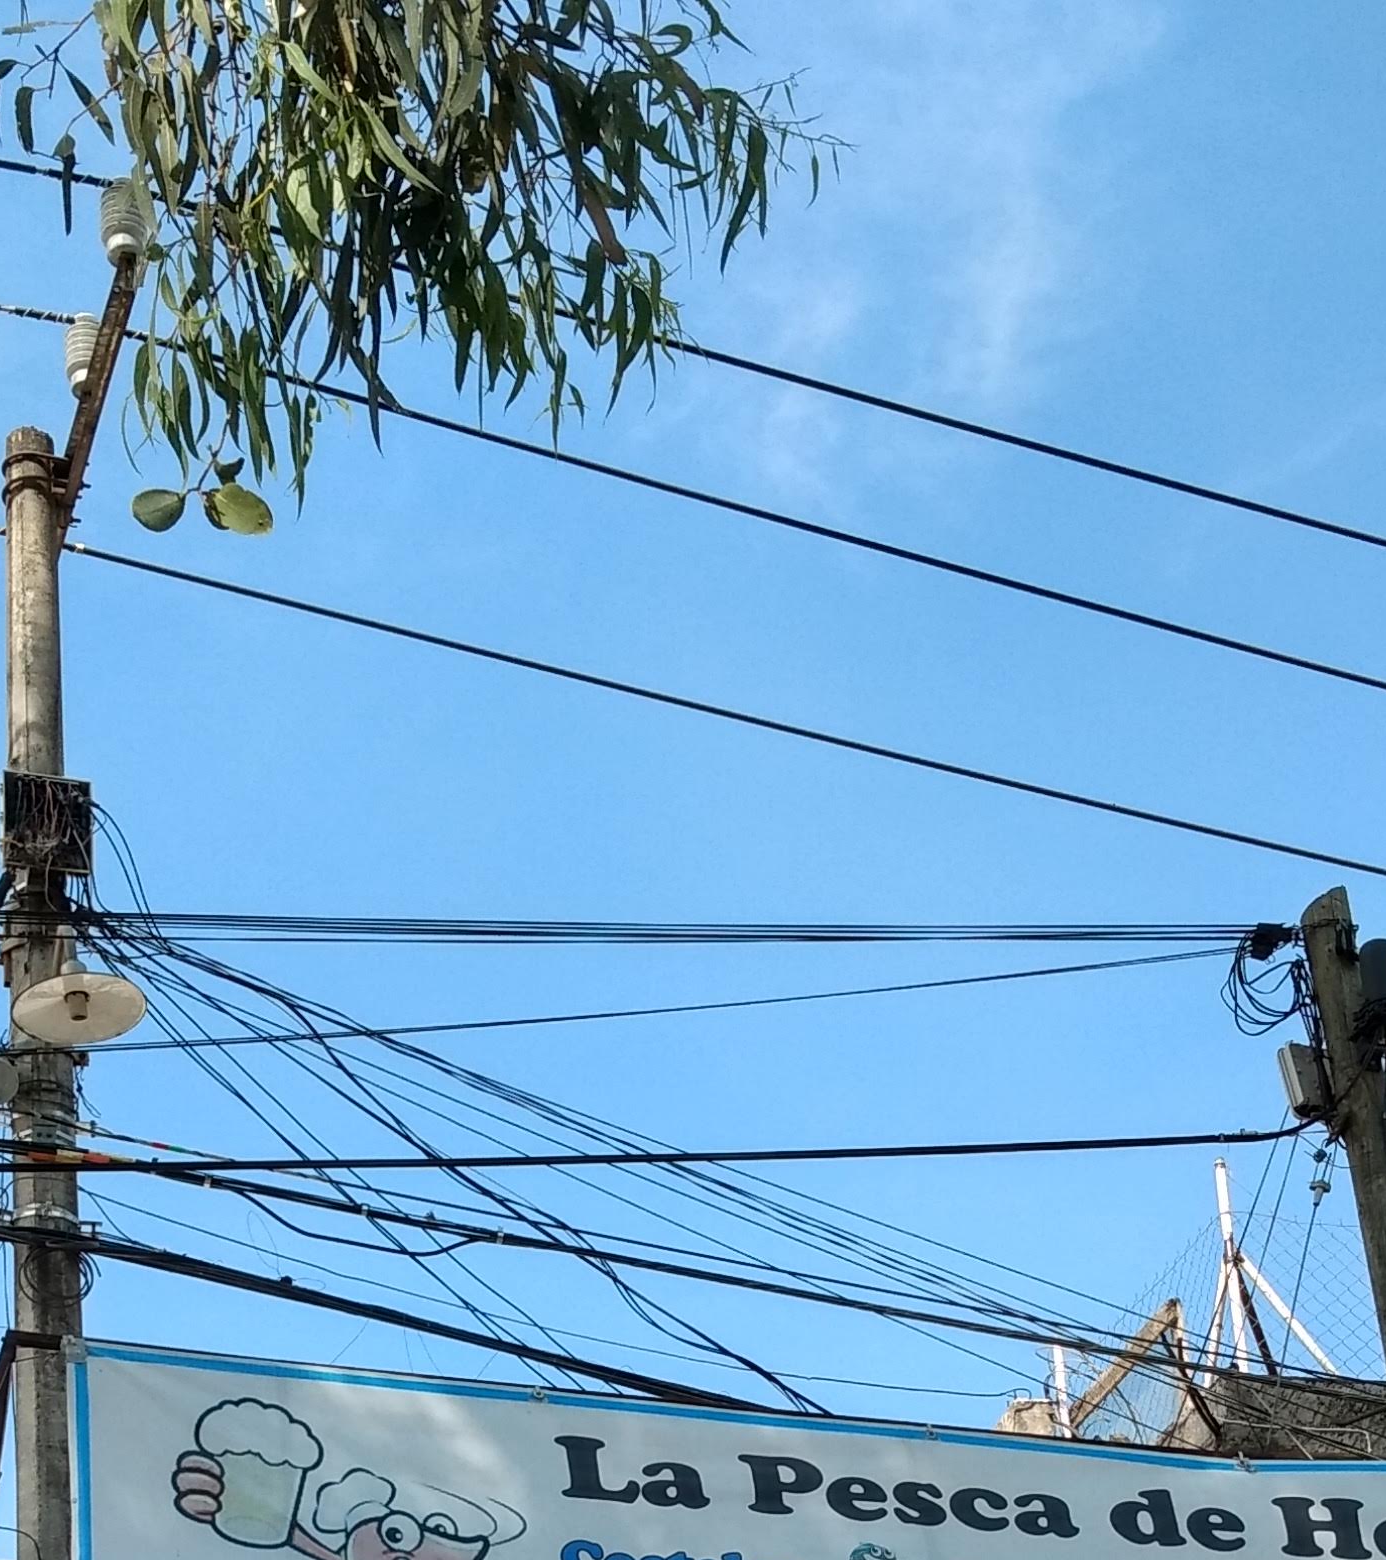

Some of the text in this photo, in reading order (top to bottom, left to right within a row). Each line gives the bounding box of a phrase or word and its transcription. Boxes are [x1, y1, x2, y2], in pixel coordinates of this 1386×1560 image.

[553, 1435, 711, 1511] La
[737, 1453, 1081, 1539] Pesca
[1109, 1488, 1247, 1553] de
